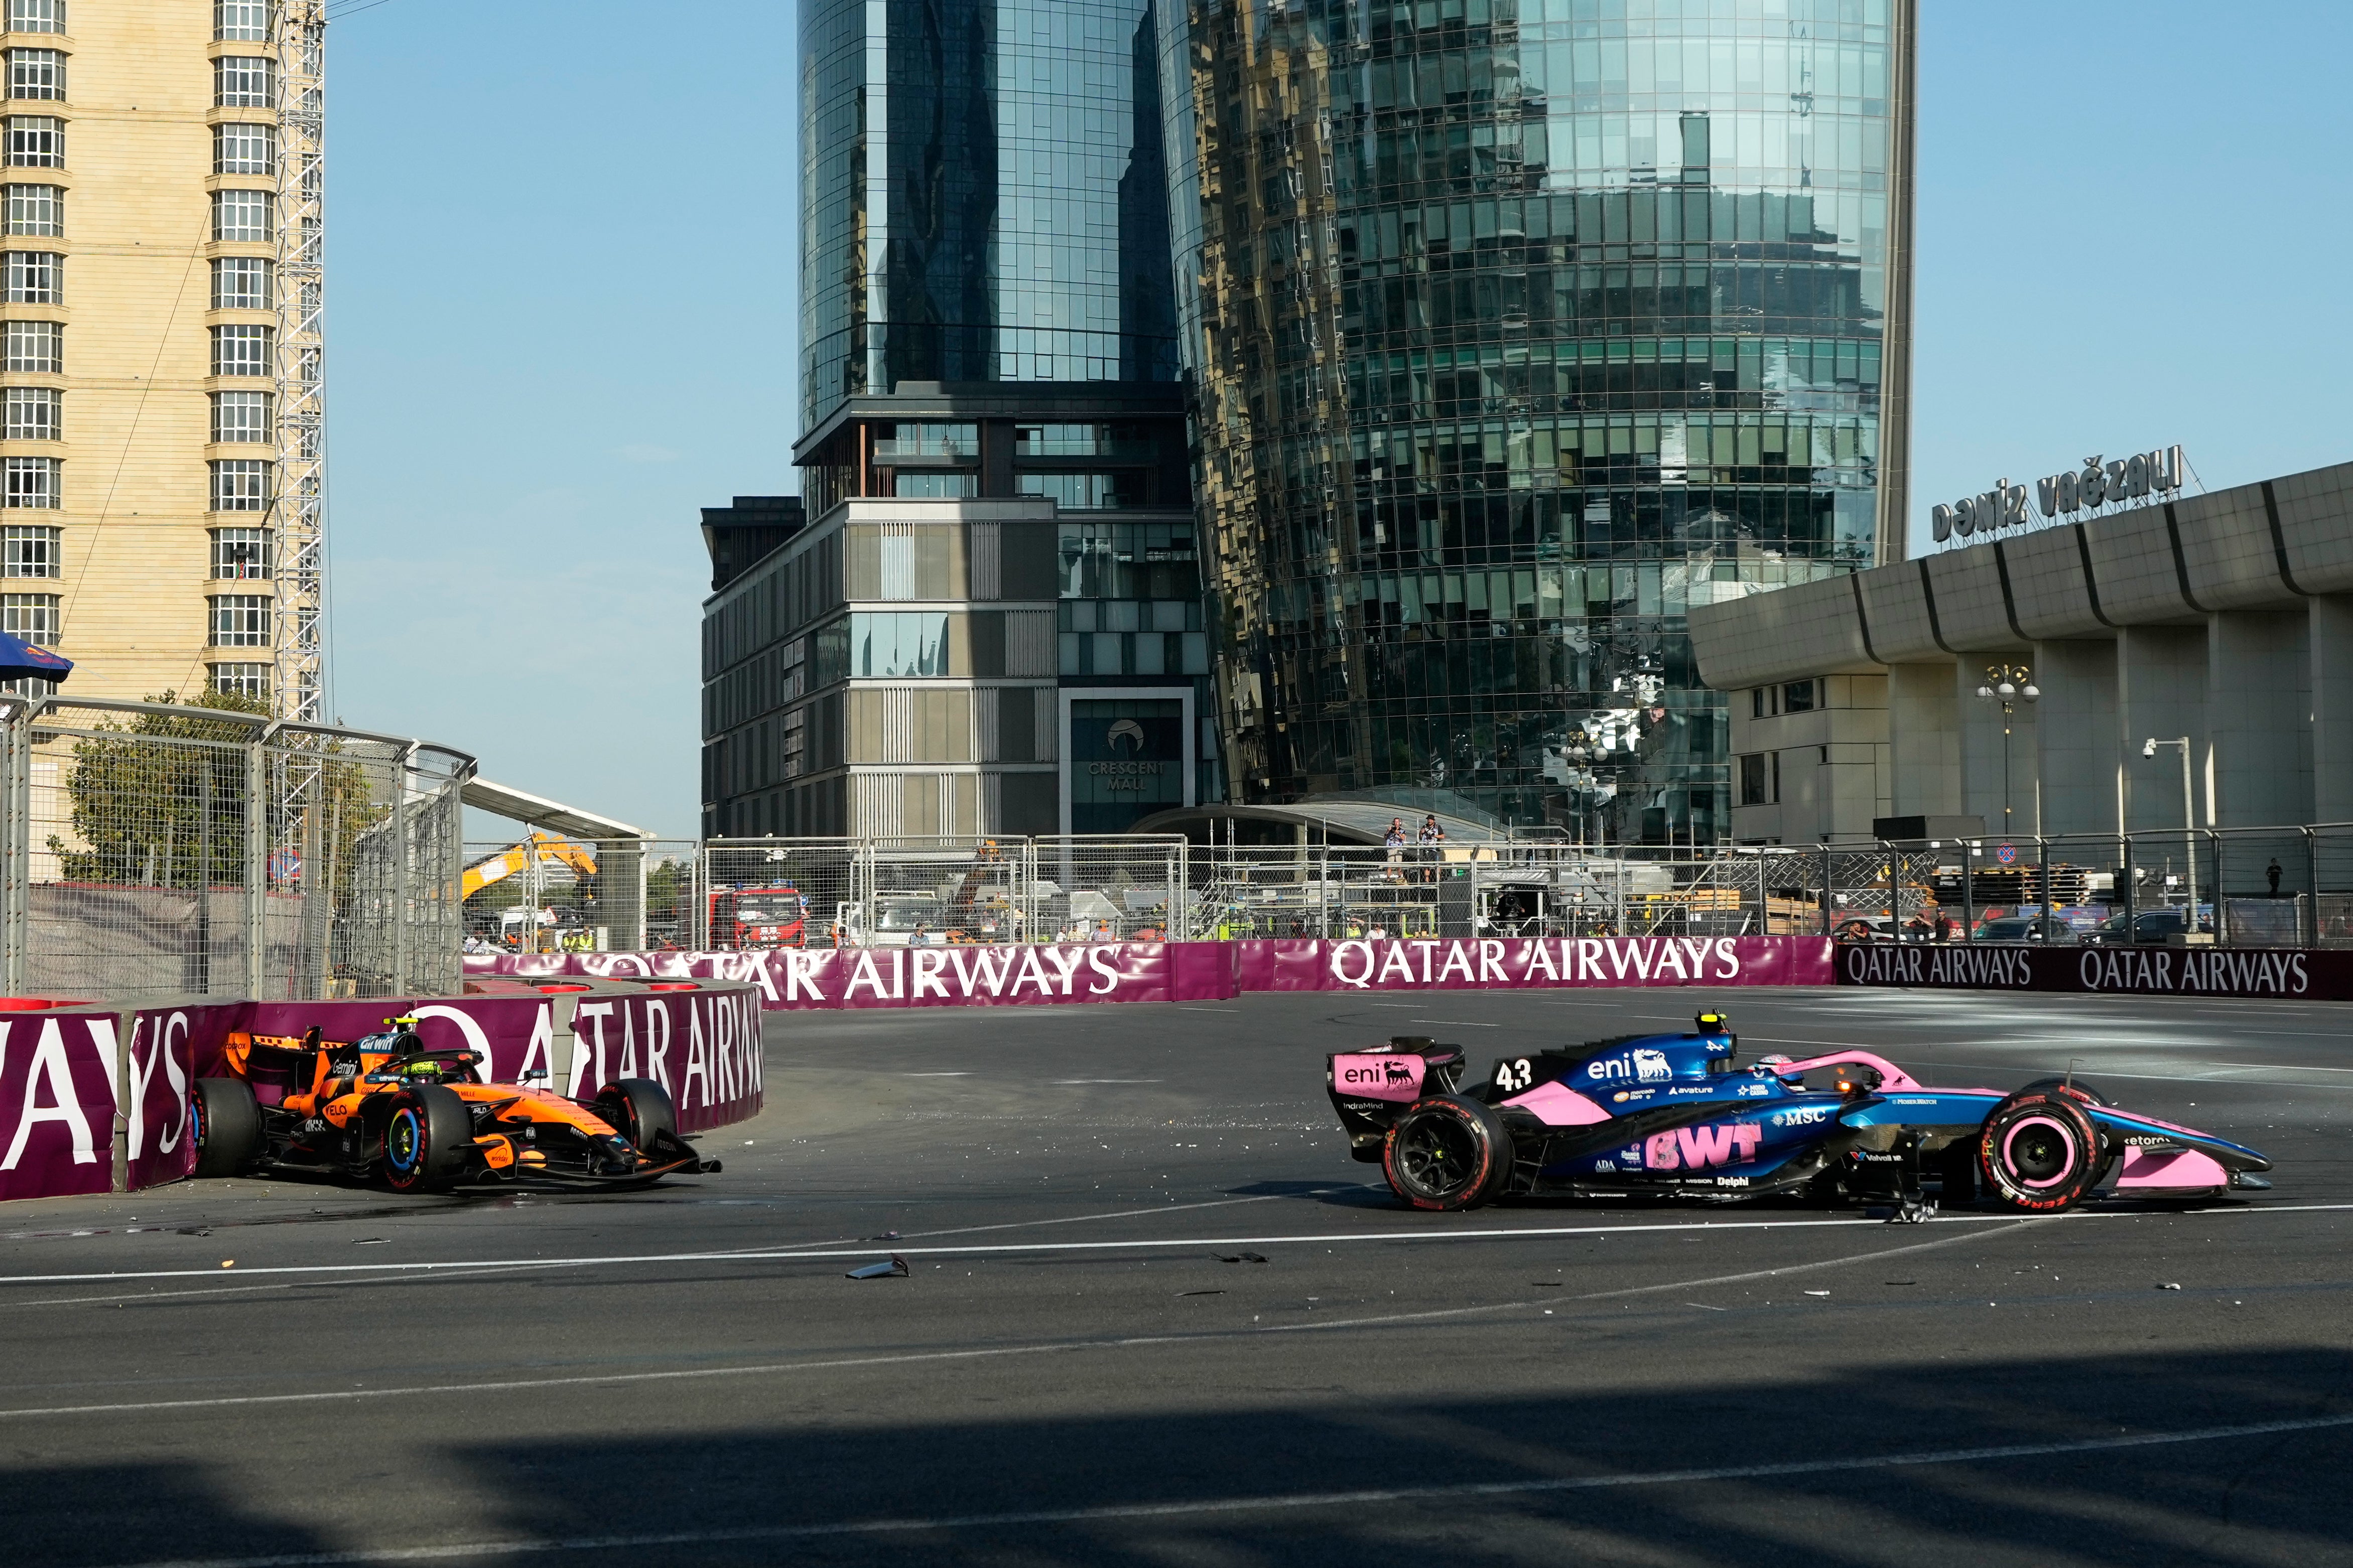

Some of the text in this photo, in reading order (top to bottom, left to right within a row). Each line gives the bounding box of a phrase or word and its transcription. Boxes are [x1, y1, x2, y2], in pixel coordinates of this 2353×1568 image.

[1932, 445, 2182, 542] DƏNİZ VAĞZALI
[1088, 762, 1165, 775] CRESCENT
[1107, 778, 1146, 790] MALL
[844, 946, 1119, 1000] AIRWAYS
[1331, 938, 1740, 988] QATAR AIRWAYS
[1848, 947, 2031, 985] QATAR AIRWAYS
[2080, 950, 2308, 993] QATAR AIRWAYS
[333, 1059, 358, 1077] Gemini
[1345, 1063, 1380, 1083] eni
[1496, 1058, 1532, 1091] 43
[1588, 1052, 1631, 1079] eni
[0, 1011, 188, 1170] AYS
[325, 1104, 347, 1116] VELO
[1785, 1108, 1826, 1126] MSC
[1646, 1124, 1763, 1170] BWT
[491, 1155, 509, 1163] workday
[1596, 1160, 1616, 1169] ADA
[1717, 1177, 1749, 1187] Delphi
